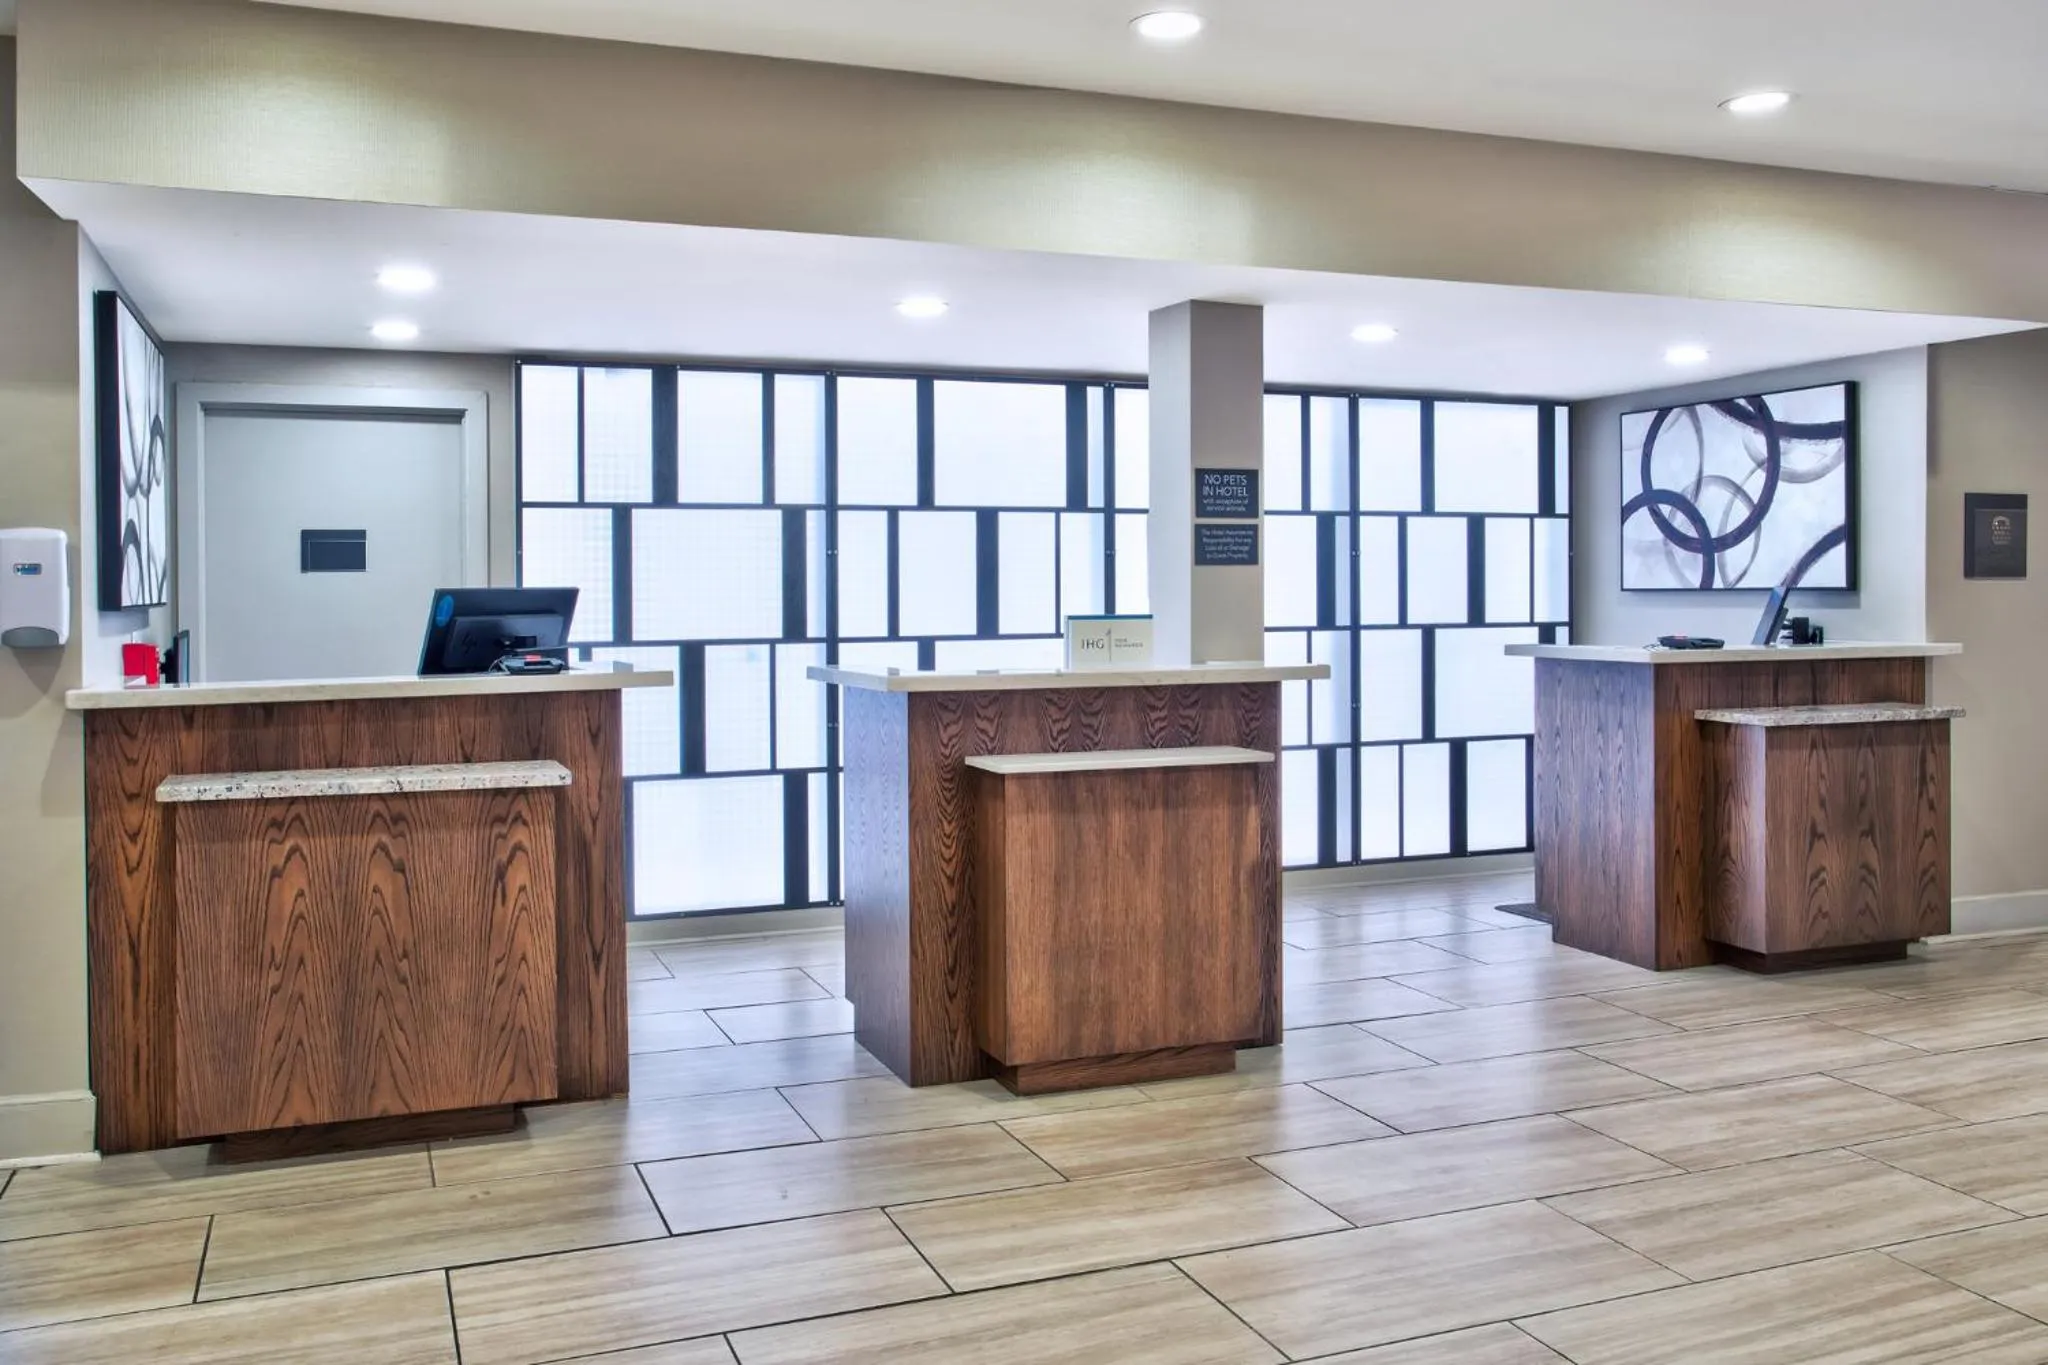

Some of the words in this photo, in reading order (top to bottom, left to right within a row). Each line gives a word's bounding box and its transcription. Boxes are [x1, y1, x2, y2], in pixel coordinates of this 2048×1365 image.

[1204, 474, 1221, 485] NO
[1223, 474, 1248, 485] PETS
[1202, 486, 1213, 496] IN
[1216, 486, 1249, 497] HOTEL
[1081, 638, 1105, 650] IHG
